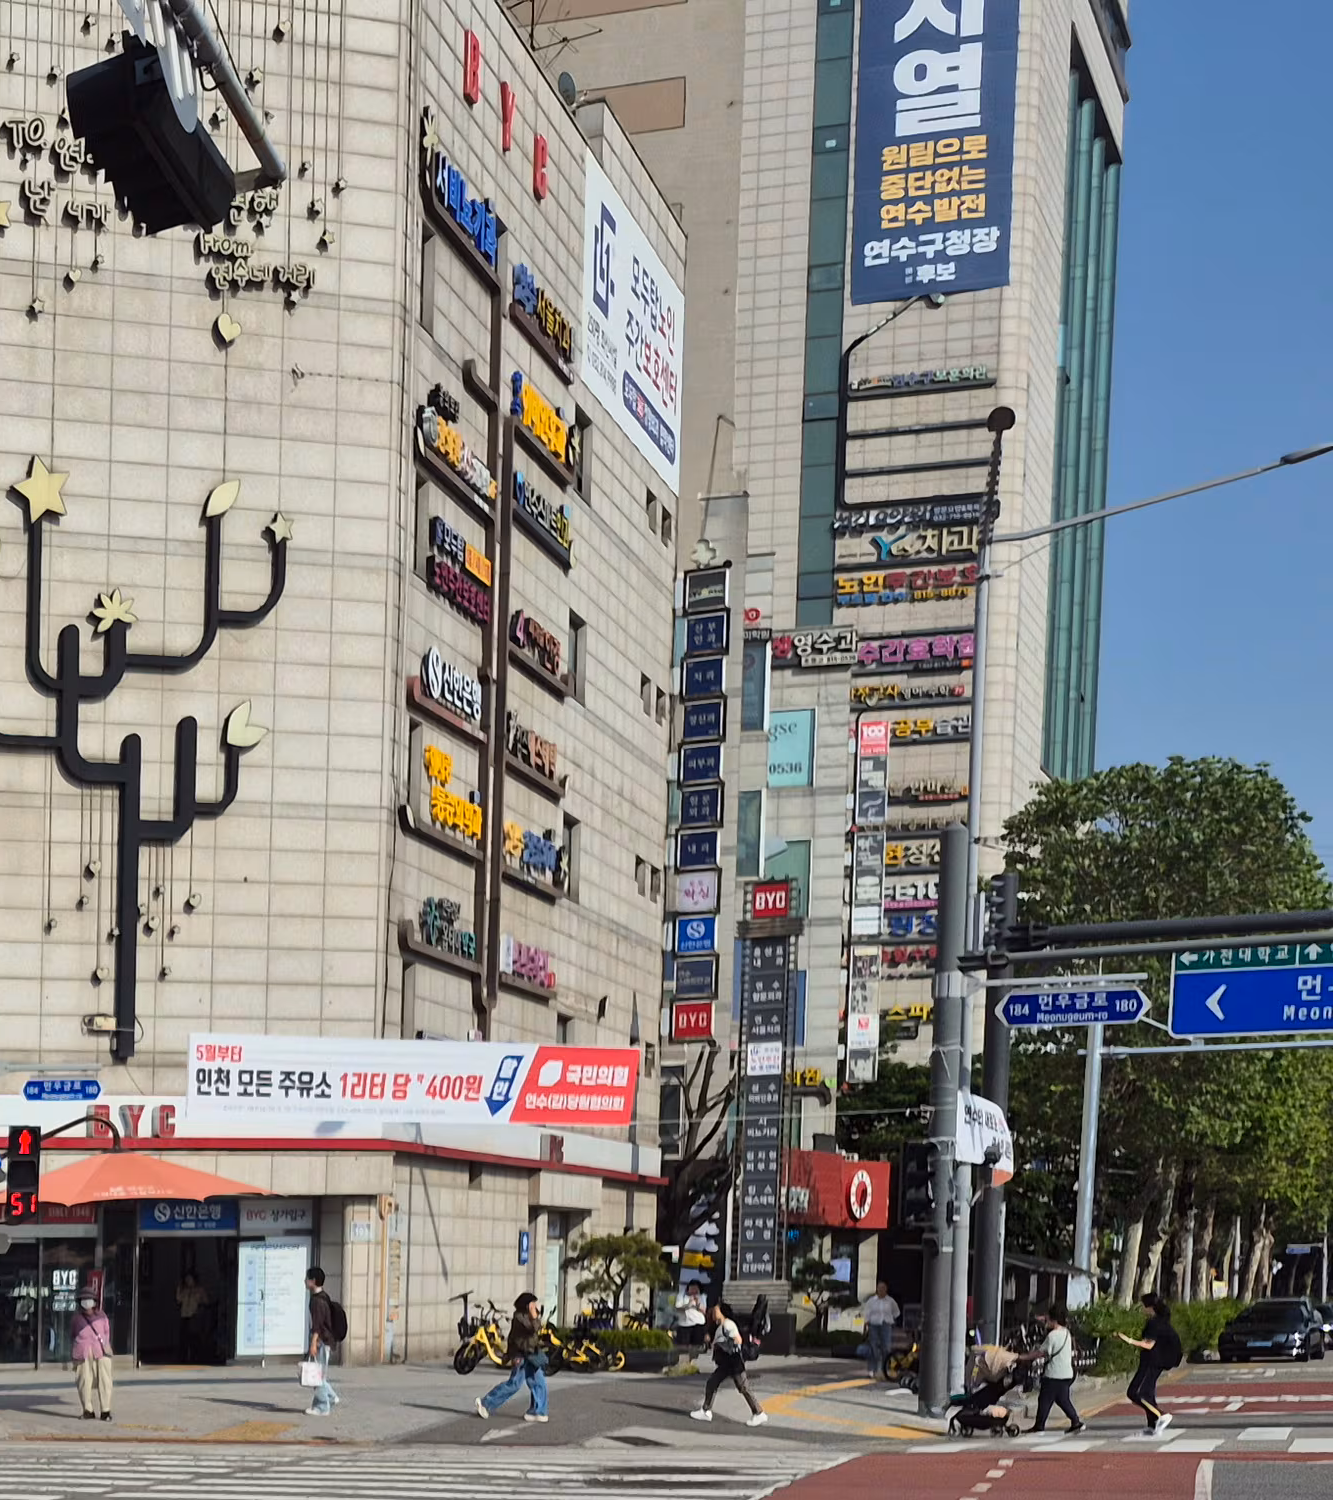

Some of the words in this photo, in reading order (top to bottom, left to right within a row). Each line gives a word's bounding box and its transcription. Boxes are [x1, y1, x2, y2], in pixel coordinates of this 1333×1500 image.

[463, 29, 549, 200] BYC
[880, 166, 986, 200] 중단없는
[880, 194, 986, 229] 연수발전
[864, 226, 1000, 267] 연수구청장
[916, 262, 956, 284] 후보
[625, 308, 678, 416] 주간보호센터
[919, 525, 980, 557] 치과
[444, 661, 482, 721] 신한은행
[755, 891, 786, 911] BYC
[1009, 1004, 1030, 1017] 184
[1038, 993, 1109, 1010] 먼우금로
[1115, 999, 1137, 1014] 180
[1037, 1011, 1109, 1024] Meonugeum-ro
[196, 1044, 243, 1064] 5월부터
[196, 1068, 231, 1098] 인천
[237, 1070, 273, 1098] 모든
[278, 1070, 332, 1099] 주유소
[339, 1073, 386, 1101] 1리터
[391, 1073, 412, 1101] 당
[426, 1074, 484, 1102] 400원
[566, 1064, 630, 1088] 국민의힘
[90, 1104, 176, 1138] BYC
[11, 1192, 37, 1216] 51
[173, 1204, 221, 1220] 신한은행
[246, 1209, 266, 1221] BYC
[52, 1270, 78, 1285] BYC
